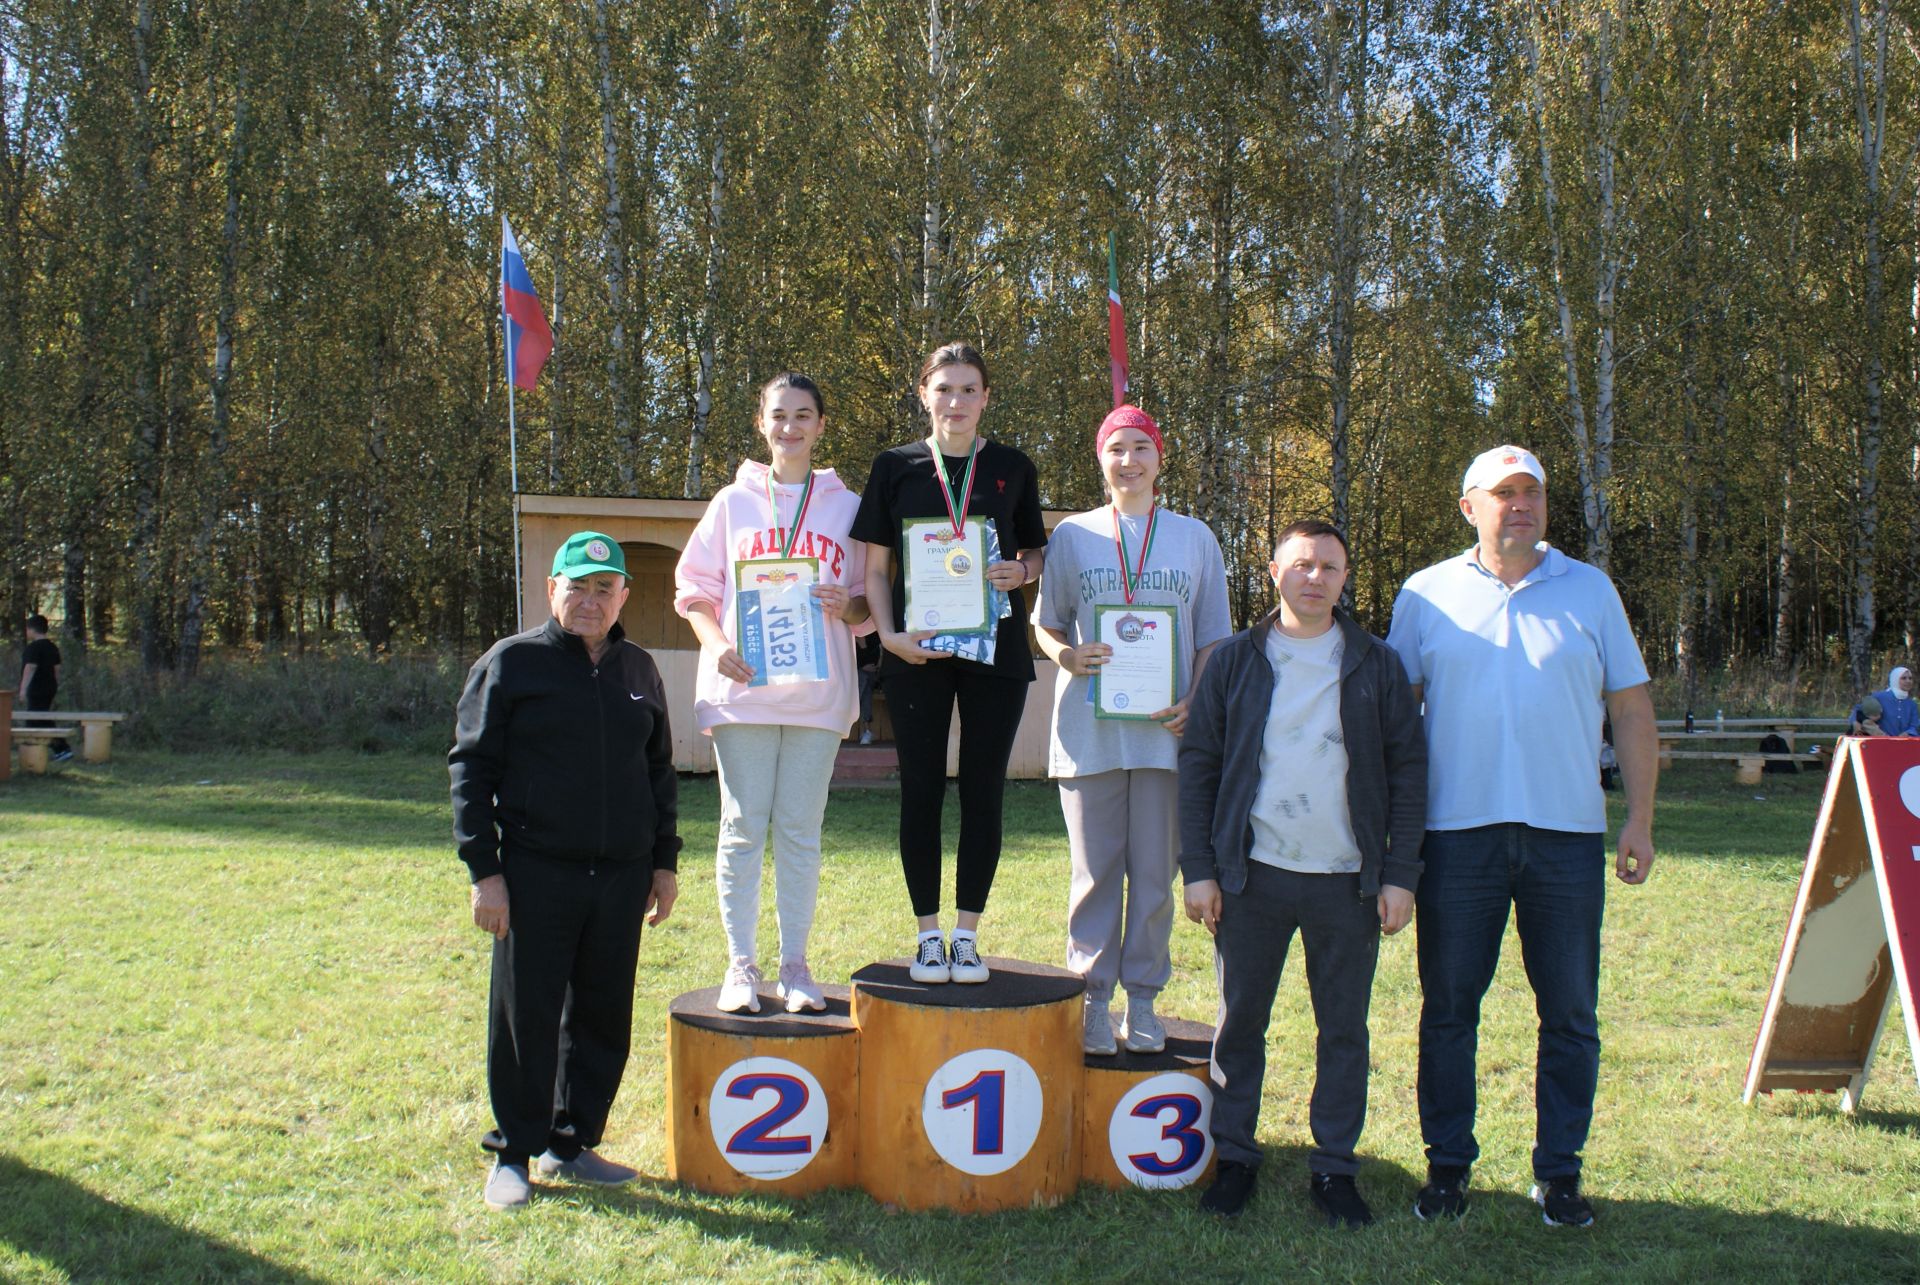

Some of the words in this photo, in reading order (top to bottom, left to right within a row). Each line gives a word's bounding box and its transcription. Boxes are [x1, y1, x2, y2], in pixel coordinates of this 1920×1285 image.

[737, 527, 846, 580] RADATE
[726, 1073, 812, 1155] 2
[942, 1070, 1006, 1155] 1
[1128, 1093, 1206, 1176] 3
